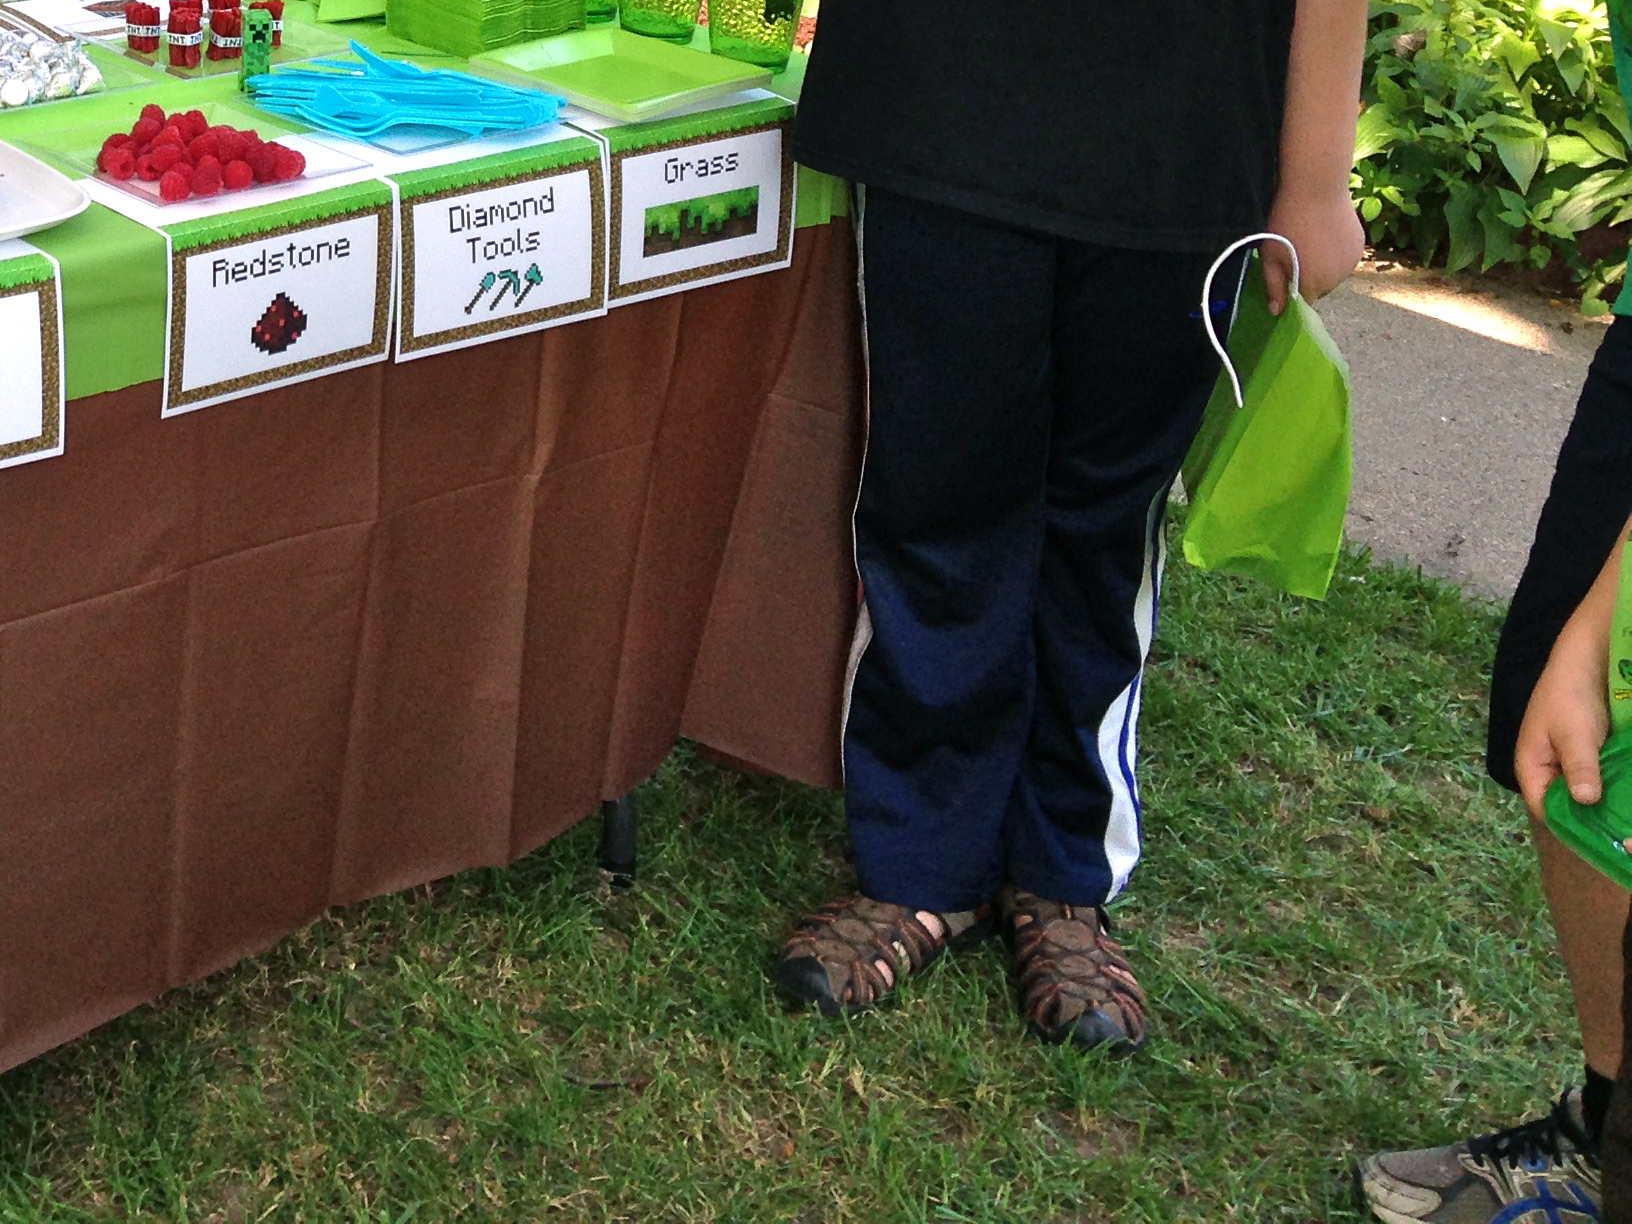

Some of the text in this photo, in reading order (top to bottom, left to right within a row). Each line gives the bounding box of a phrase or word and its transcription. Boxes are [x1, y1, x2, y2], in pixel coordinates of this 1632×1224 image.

[127, 25, 161, 36] TNT TNT
[169, 32, 203, 44] TNT TNT
[664, 151, 740, 186] Grass
[448, 186, 555, 234] Diamond
[211, 237, 351, 288] Redstone
[466, 228, 541, 264] Tools
